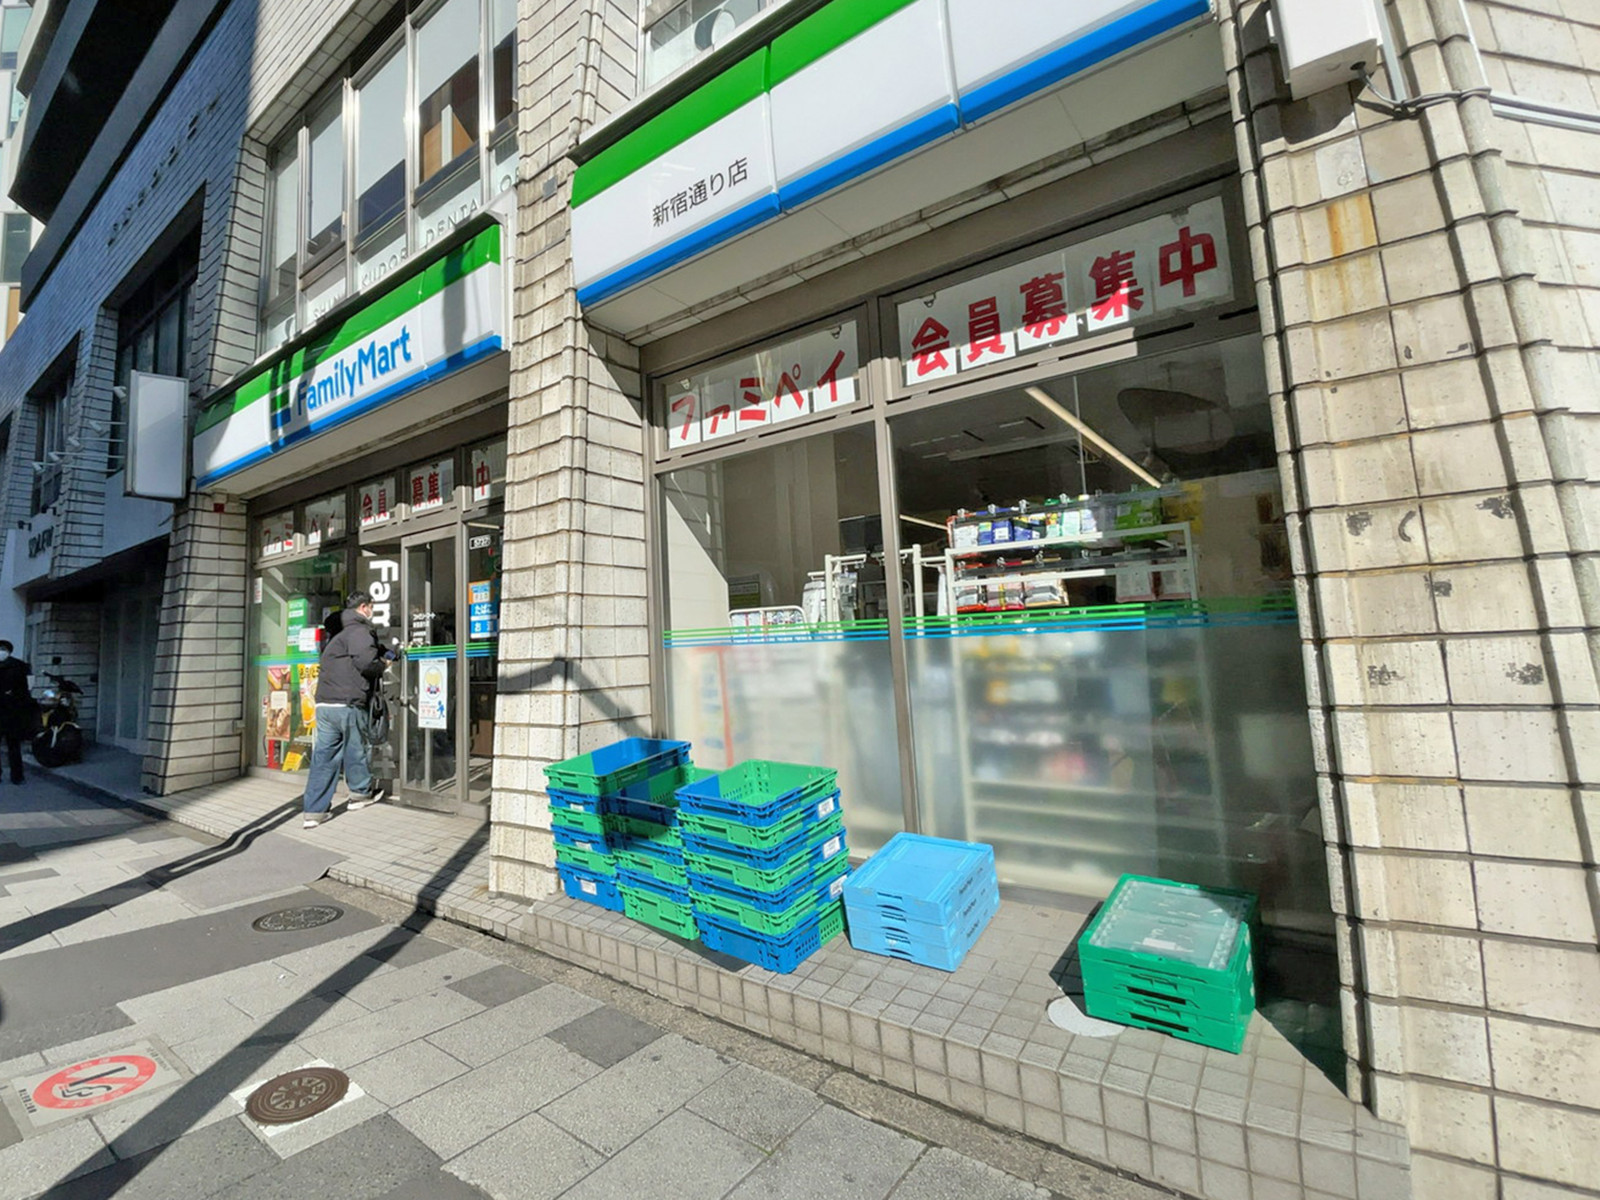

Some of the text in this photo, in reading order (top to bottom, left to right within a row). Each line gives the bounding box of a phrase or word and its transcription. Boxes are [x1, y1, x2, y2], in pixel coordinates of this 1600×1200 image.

[653, 157, 747, 227] 新宿通り店
[297, 324, 411, 416] FamilyMart
[671, 226, 1217, 441] ファミペイ 会員募集中
